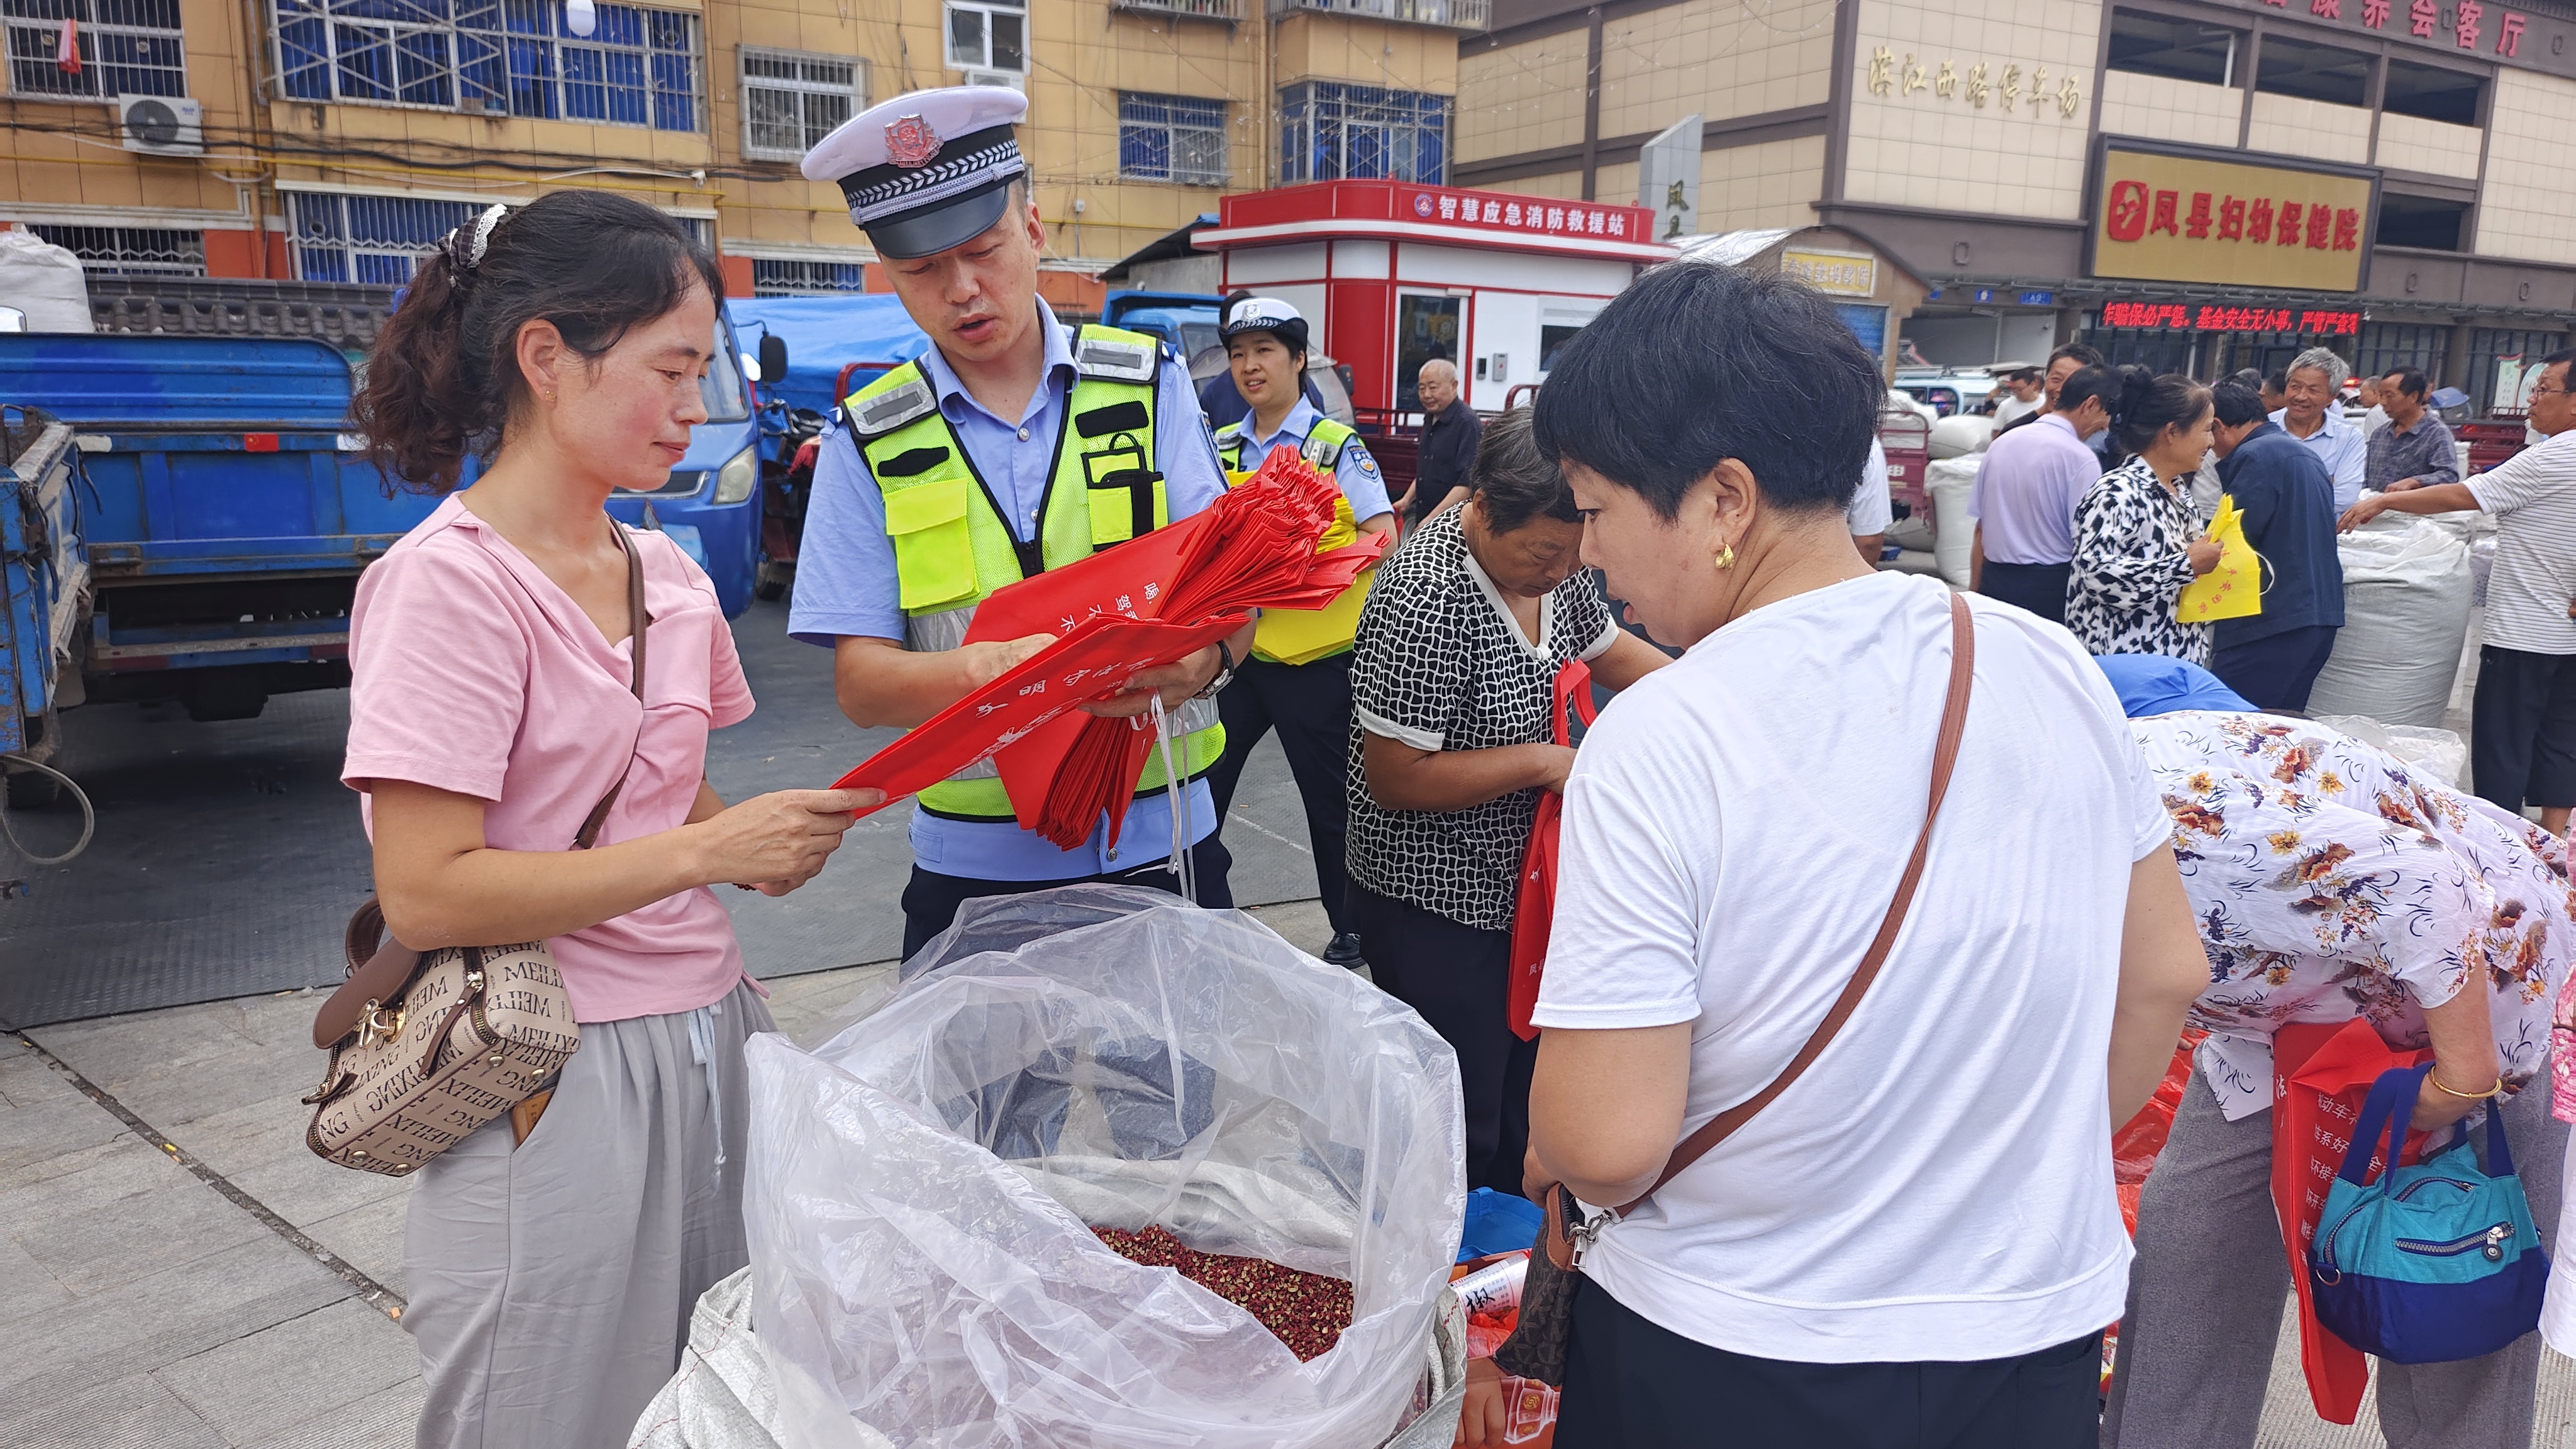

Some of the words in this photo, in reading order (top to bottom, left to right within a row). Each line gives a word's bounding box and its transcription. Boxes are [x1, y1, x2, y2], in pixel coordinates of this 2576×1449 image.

[1868, 45, 2080, 119] 滨江西路停车场
[1438, 196, 1625, 236] 智慧应急消防救援站
[2150, 190, 2360, 252] 凤县妇幼保健院
